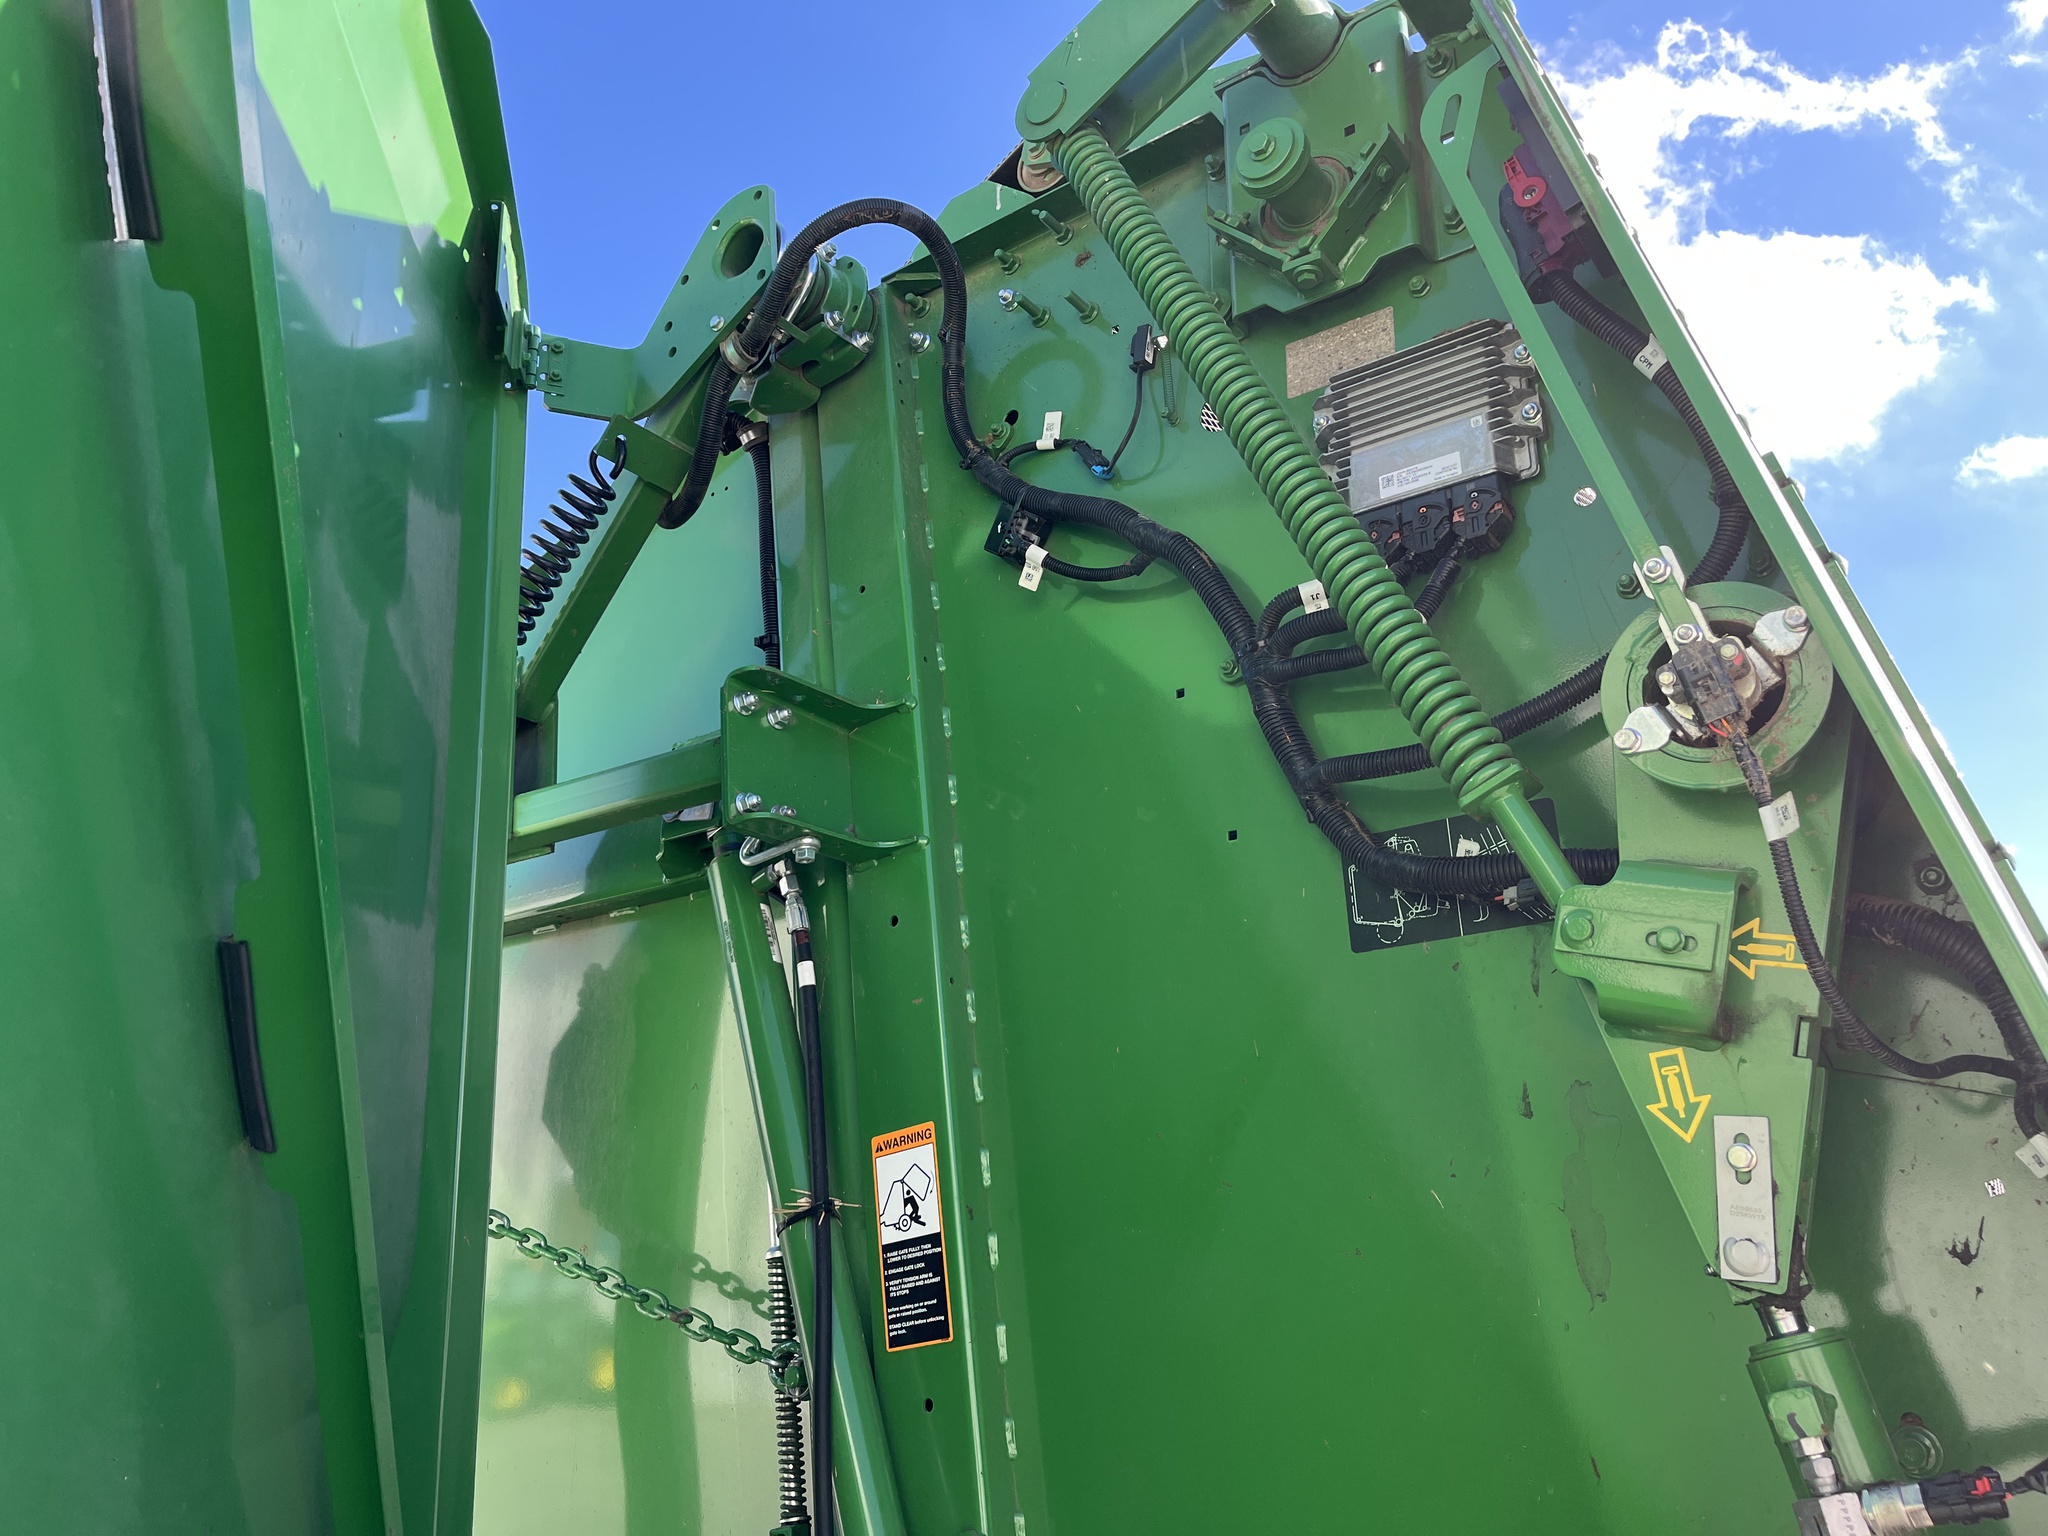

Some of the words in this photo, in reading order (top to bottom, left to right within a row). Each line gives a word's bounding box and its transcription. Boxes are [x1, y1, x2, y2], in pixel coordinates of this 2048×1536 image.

[1639, 355, 1653, 369] CPM
[1310, 592, 1320, 600] J1
[883, 1128, 932, 1150] WARNING
